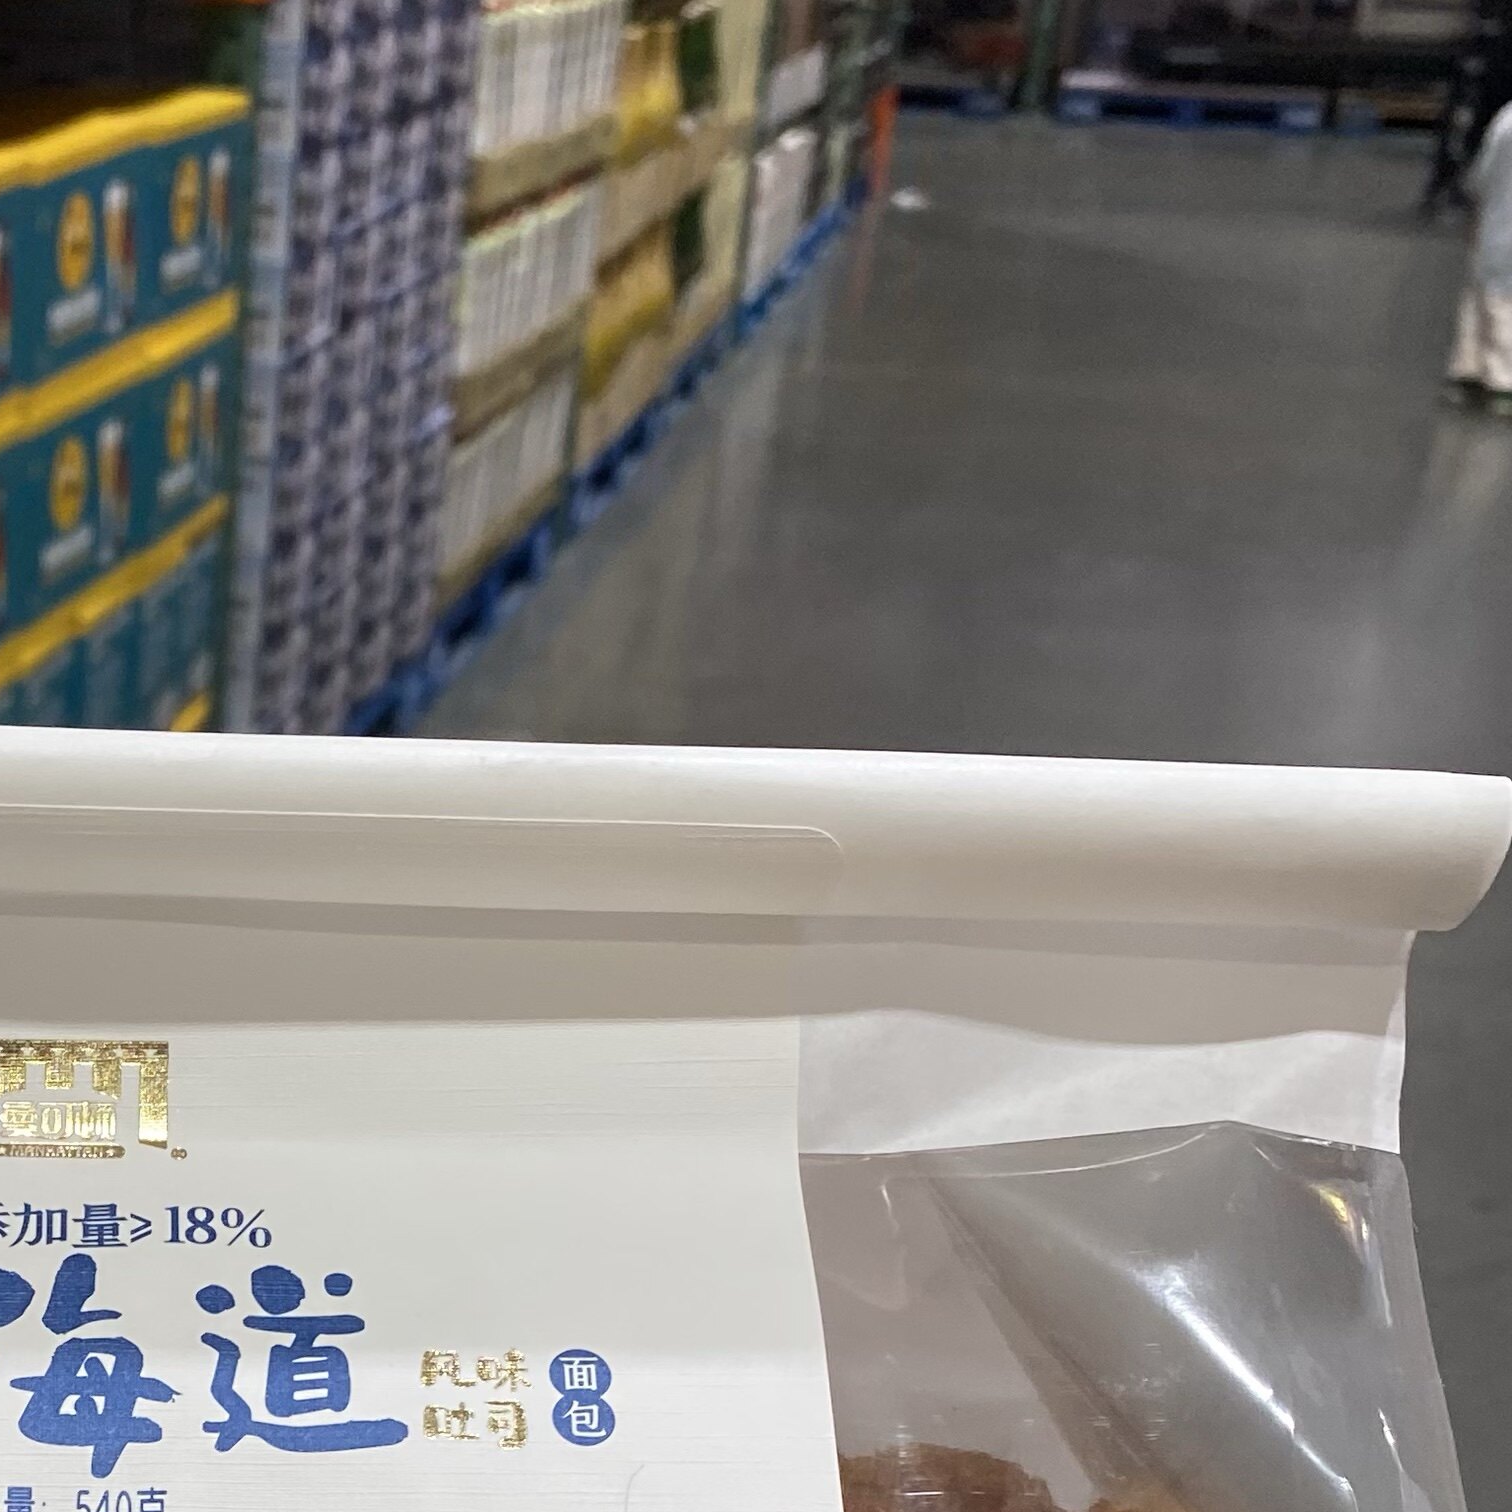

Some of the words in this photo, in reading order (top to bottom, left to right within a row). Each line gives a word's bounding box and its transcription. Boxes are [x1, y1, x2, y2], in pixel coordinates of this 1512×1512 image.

[420, 1348, 532, 1392] 风味
[557, 1355, 608, 1439] 面包
[422, 1400, 529, 1450] 吐司
